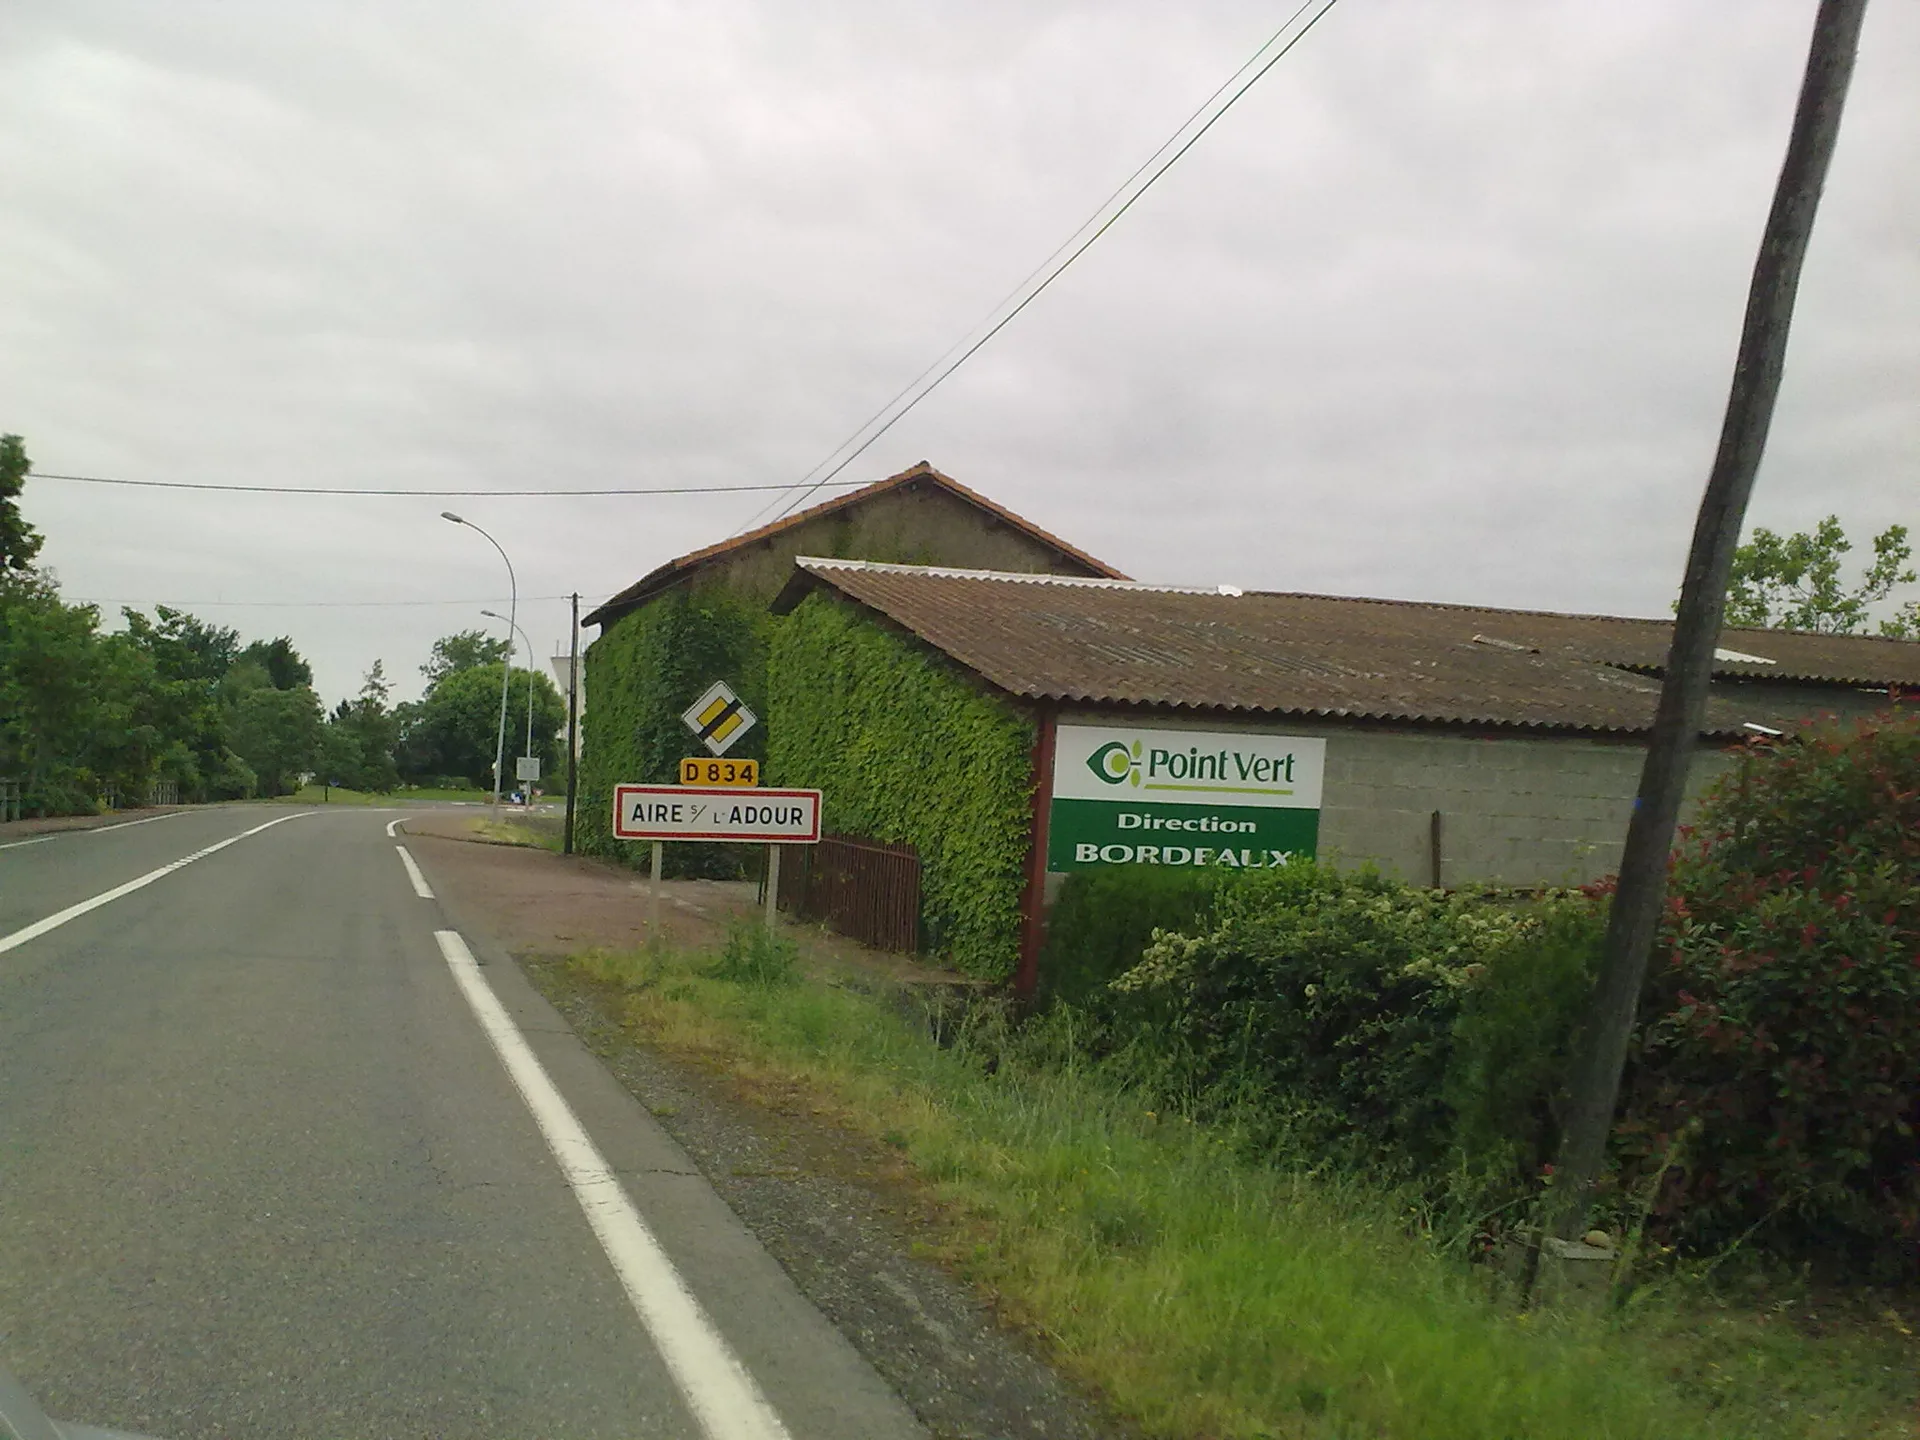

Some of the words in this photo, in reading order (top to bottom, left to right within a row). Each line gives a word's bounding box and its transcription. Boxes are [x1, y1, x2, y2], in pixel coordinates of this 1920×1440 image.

[686, 763, 699, 781] D
[707, 763, 754, 782] 834
[1149, 747, 1228, 781] Point
[1233, 752, 1295, 783] Vert
[631, 803, 683, 823] AIRE
[1117, 813, 1256, 834] Direction
